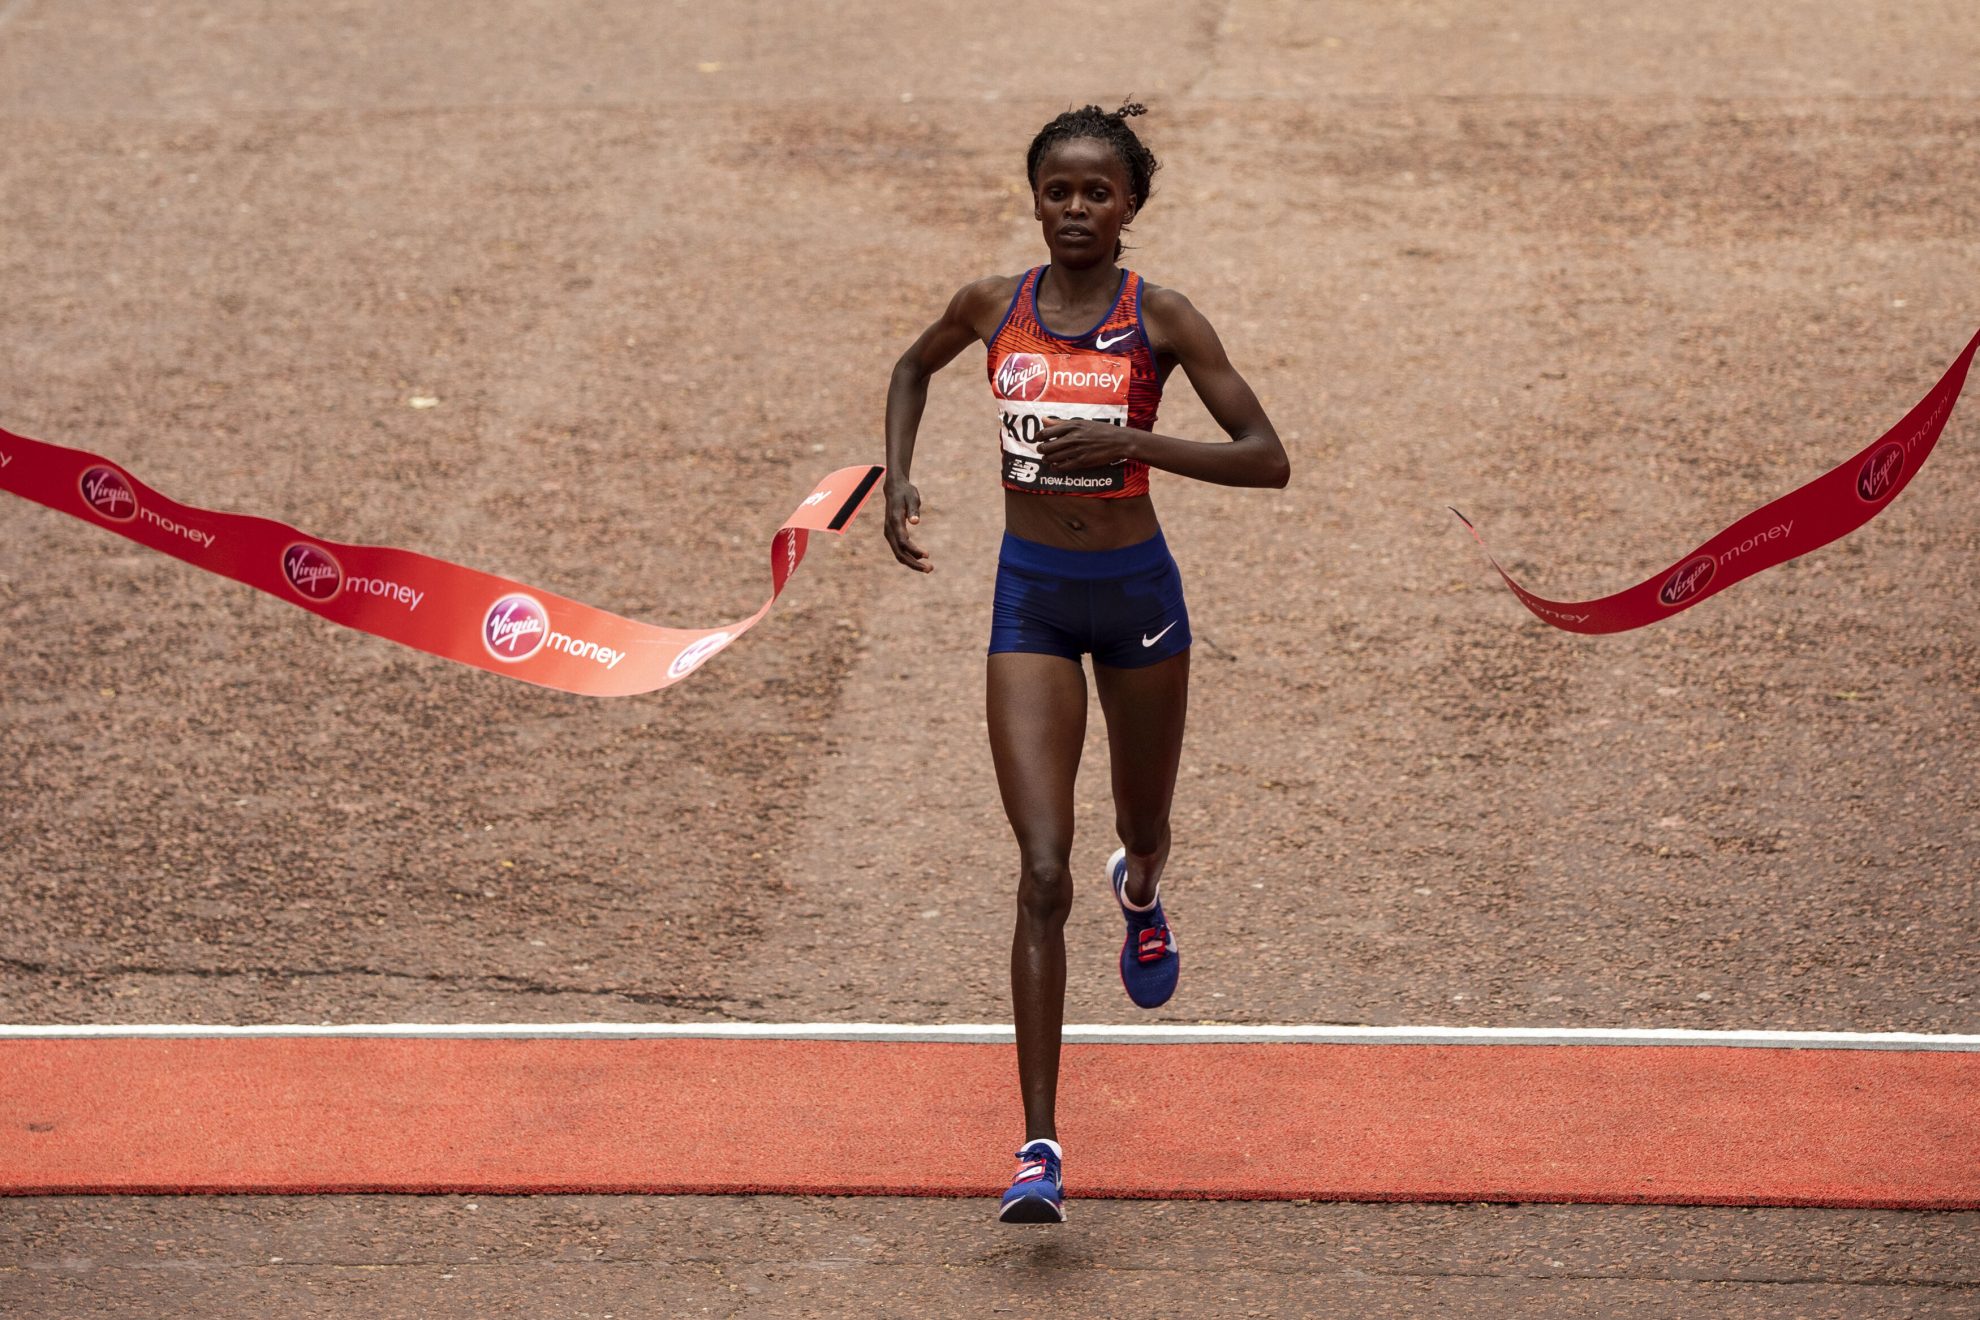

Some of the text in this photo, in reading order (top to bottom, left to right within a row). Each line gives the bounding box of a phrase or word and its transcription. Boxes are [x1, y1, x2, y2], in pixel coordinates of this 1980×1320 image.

[1000, 353, 1124, 398] Virgin money
[1862, 390, 1951, 496] Virgin money
[86, 472, 215, 548] Virgin money
[1040, 475, 1113, 487] new balance
[288, 550, 424, 611] Virgin money
[1665, 519, 1794, 600] Virgin money
[490, 602, 542, 651] Virgin
[547, 631, 625, 669] money
